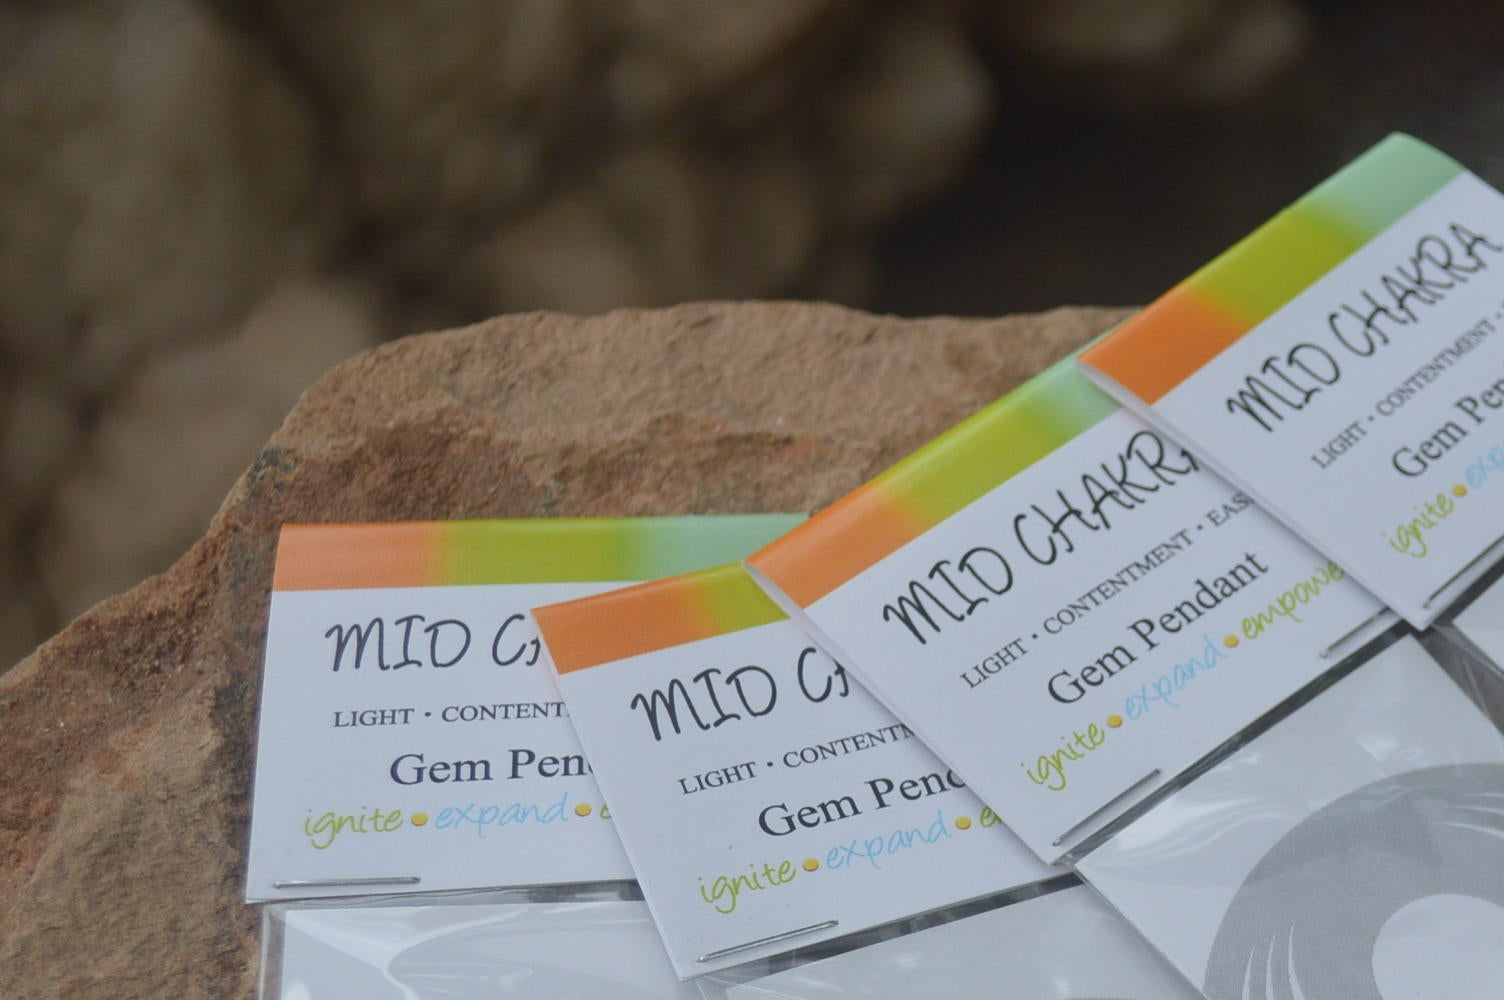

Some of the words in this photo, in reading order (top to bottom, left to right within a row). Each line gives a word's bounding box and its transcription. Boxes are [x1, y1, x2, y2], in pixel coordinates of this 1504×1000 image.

[1226, 342, 1341, 432] MID
[1328, 222, 1504, 357] CHAKRA
[1311, 420, 1368, 469] LIGHT
[1376, 317, 1497, 417] CONTENTMENT
[1392, 420, 1470, 477] Gem
[1381, 492, 1455, 558] ignite
[883, 547, 1013, 645] MID
[959, 637, 1030, 692] LIGHT
[1043, 529, 1195, 634] CONTENTMENT
[1206, 492, 1255, 526] EAS
[324, 614, 471, 673] MID
[1047, 644, 1138, 705] Gem
[1127, 552, 1269, 651] Pendant
[630, 664, 778, 741] MID
[1020, 722, 1107, 791] ignite
[1123, 634, 1229, 723] expand
[1240, 560, 1345, 640] empowe
[332, 707, 415, 728] LIGHT
[441, 701, 570, 723] CONTENT
[389, 753, 493, 786] Gem
[506, 748, 593, 780] Pen
[677, 761, 757, 796] LIGHT
[304, 806, 404, 850] ignite
[434, 791, 569, 839] expand
[757, 794, 862, 838] Gem
[698, 857, 797, 913] ignite
[826, 808, 952, 871] expand
